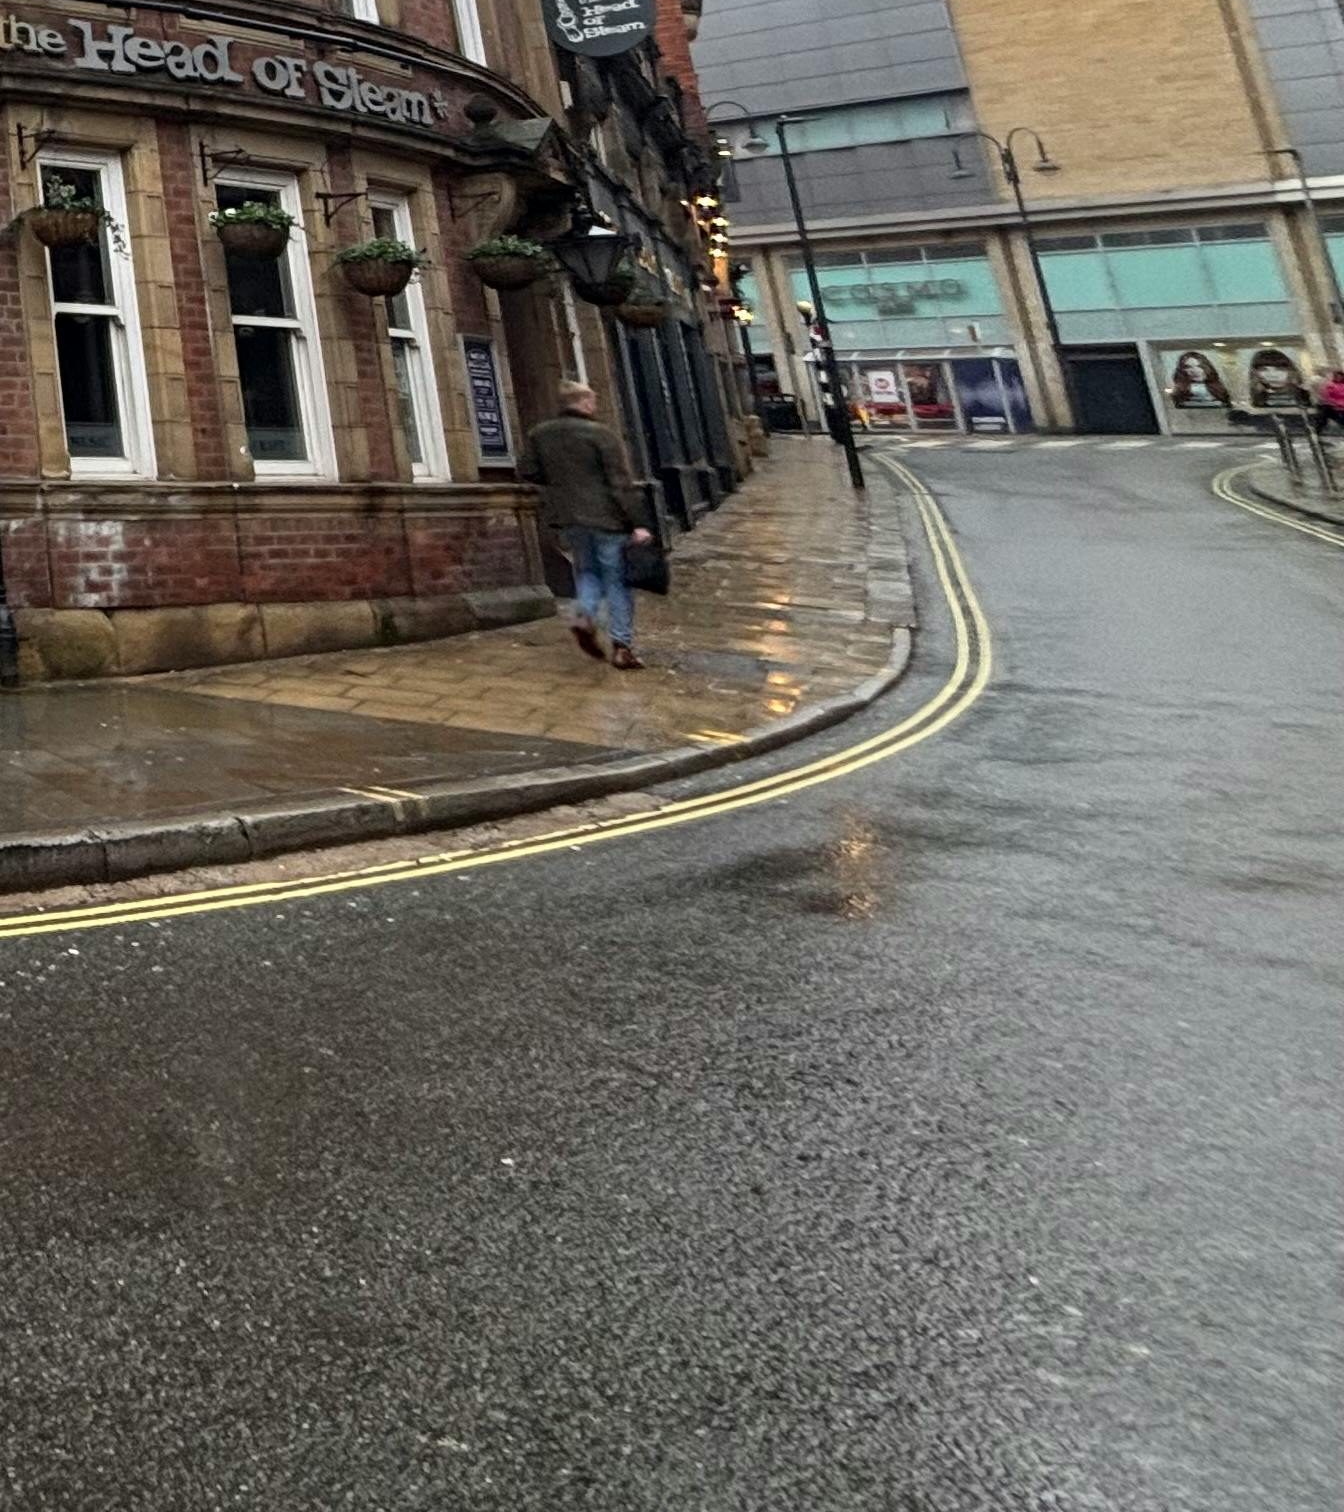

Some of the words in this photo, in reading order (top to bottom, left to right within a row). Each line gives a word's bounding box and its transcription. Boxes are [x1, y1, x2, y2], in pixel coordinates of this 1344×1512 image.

[583, 21, 647, 39] Steam
[67, 18, 245, 84] Head
[312, 60, 434, 126] Steam
